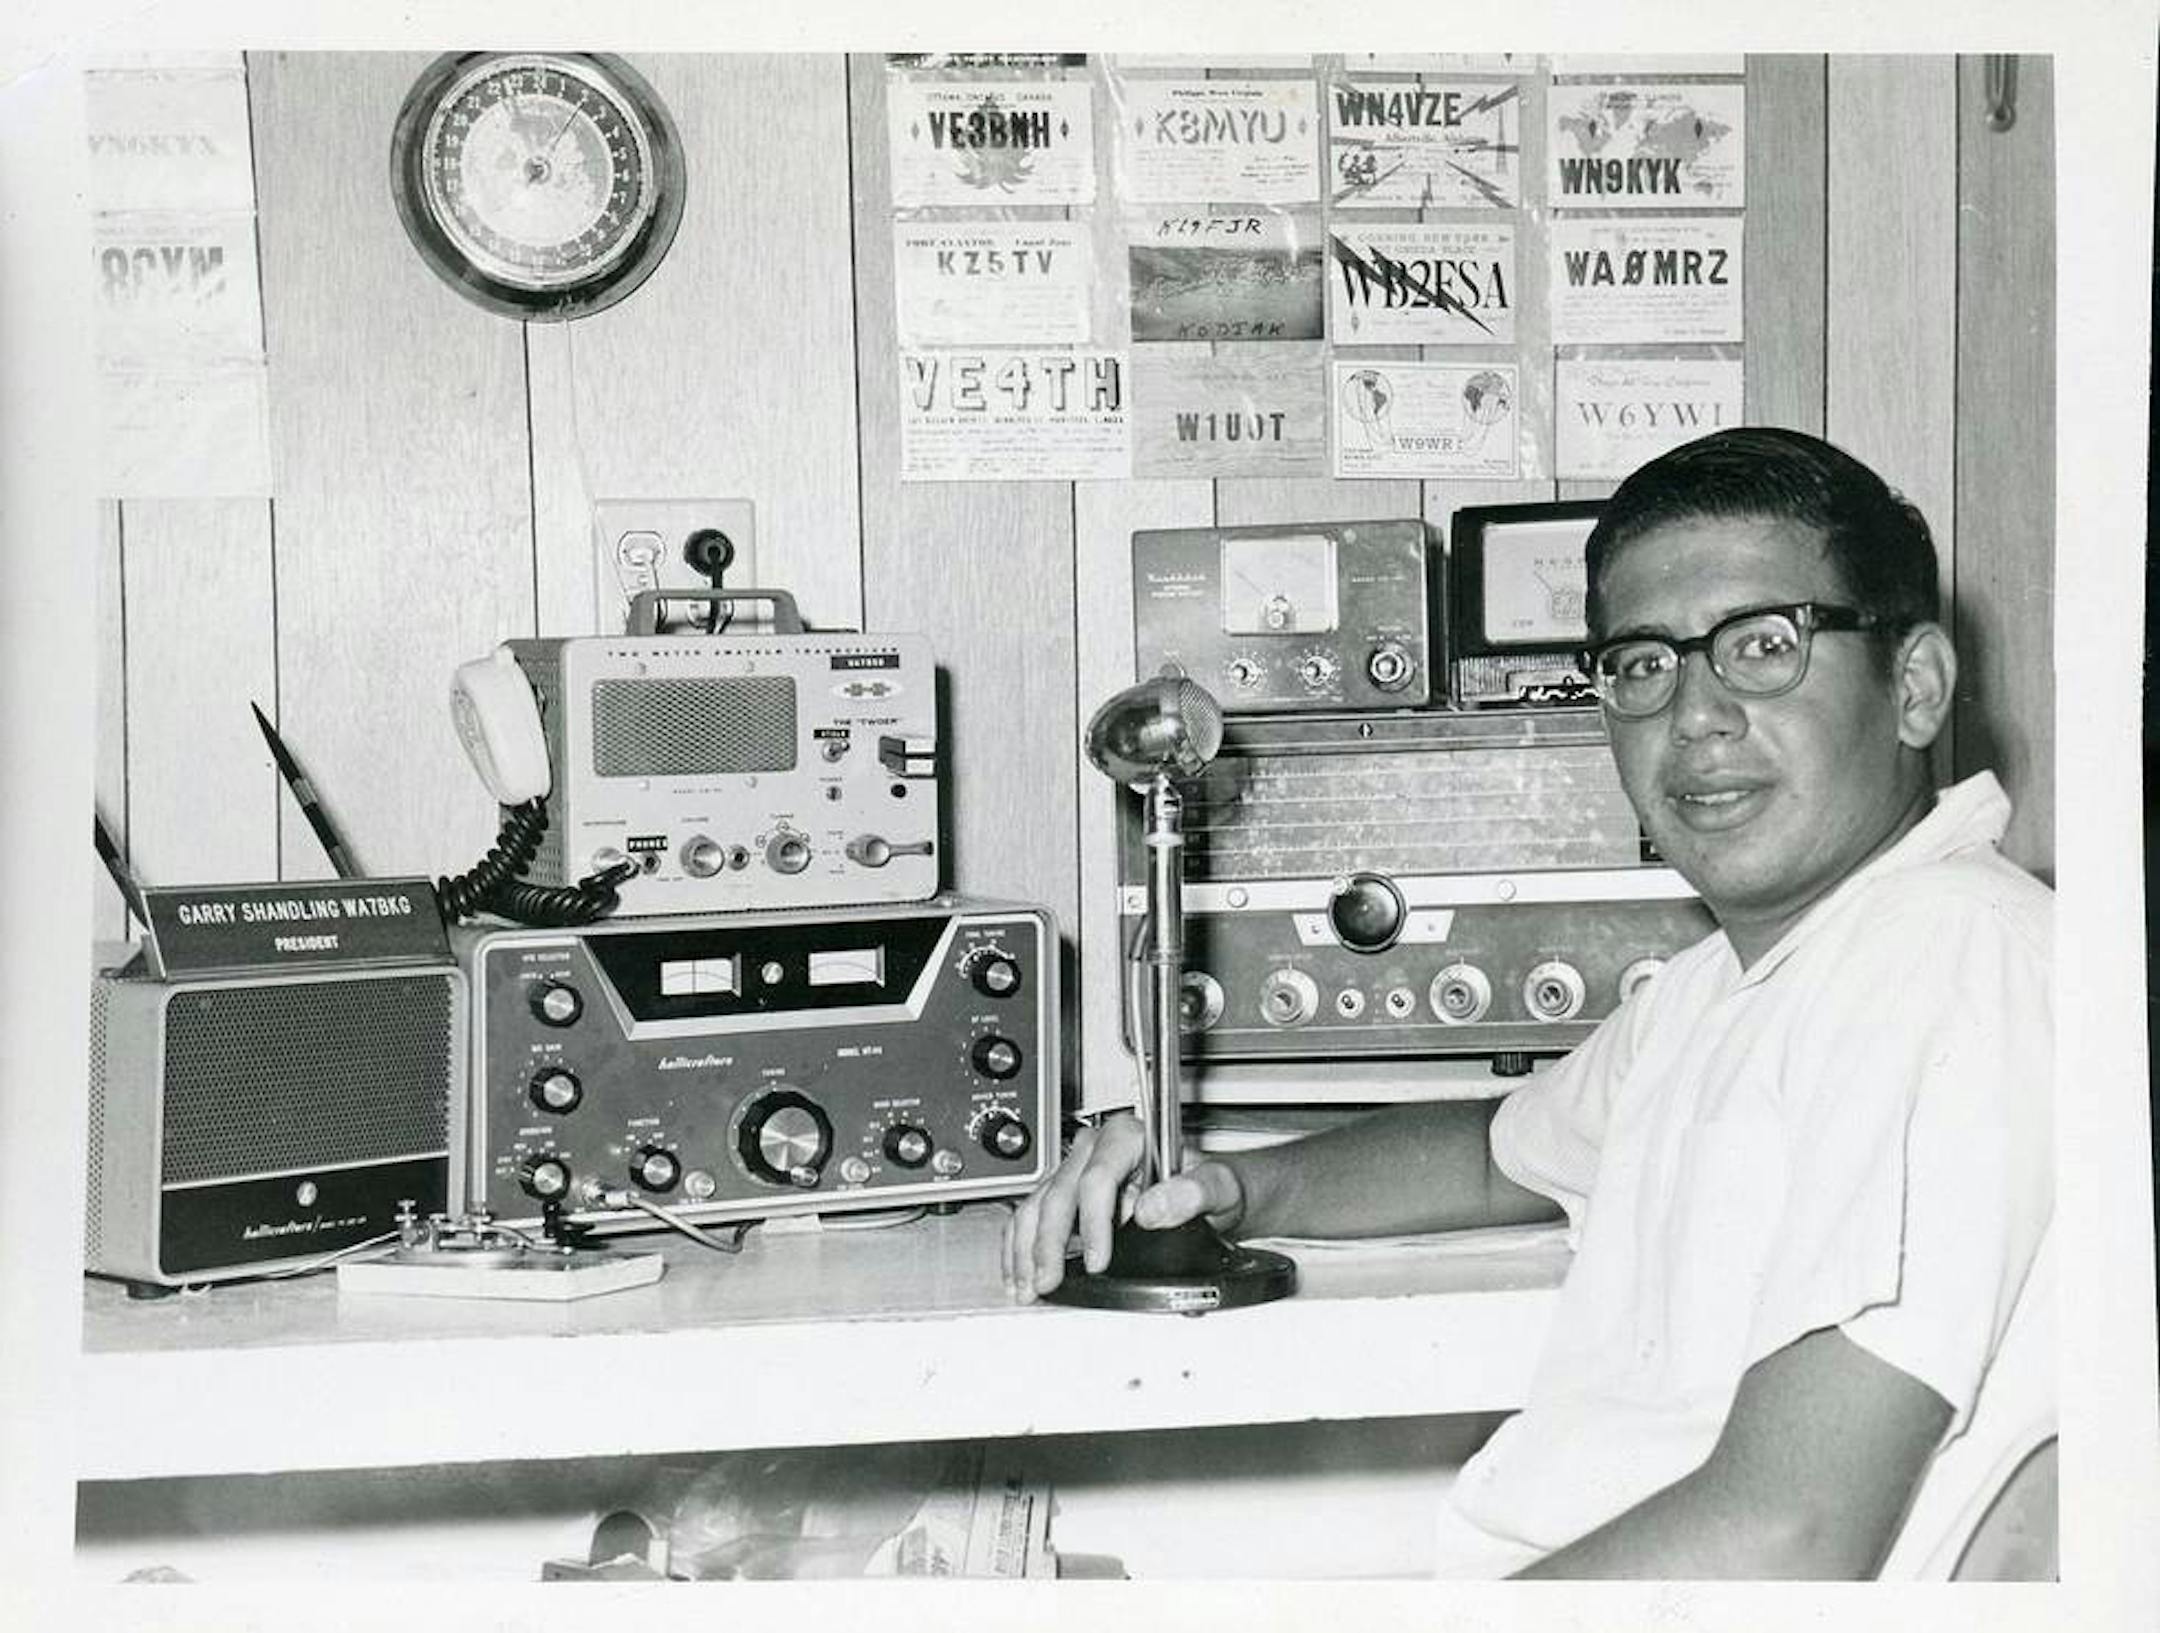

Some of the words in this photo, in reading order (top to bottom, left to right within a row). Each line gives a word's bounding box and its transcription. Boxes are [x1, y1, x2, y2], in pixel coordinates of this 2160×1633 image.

[1155, 108, 1288, 144] K8MYU
[1336, 92, 1462, 126] WN4VZE
[928, 112, 1051, 149] VE3BNH
[1559, 158, 1682, 194] WN9KYK
[937, 250, 1053, 275] KZ5TV
[1179, 320, 1285, 338] KODIAK
[905, 356, 1123, 412] VE4TH
[178, 902, 238, 926] GARRY
[242, 898, 341, 924] SHANDLING
[341, 895, 413, 918] WA7BKG
[274, 935, 340, 953] PRESIDENT
